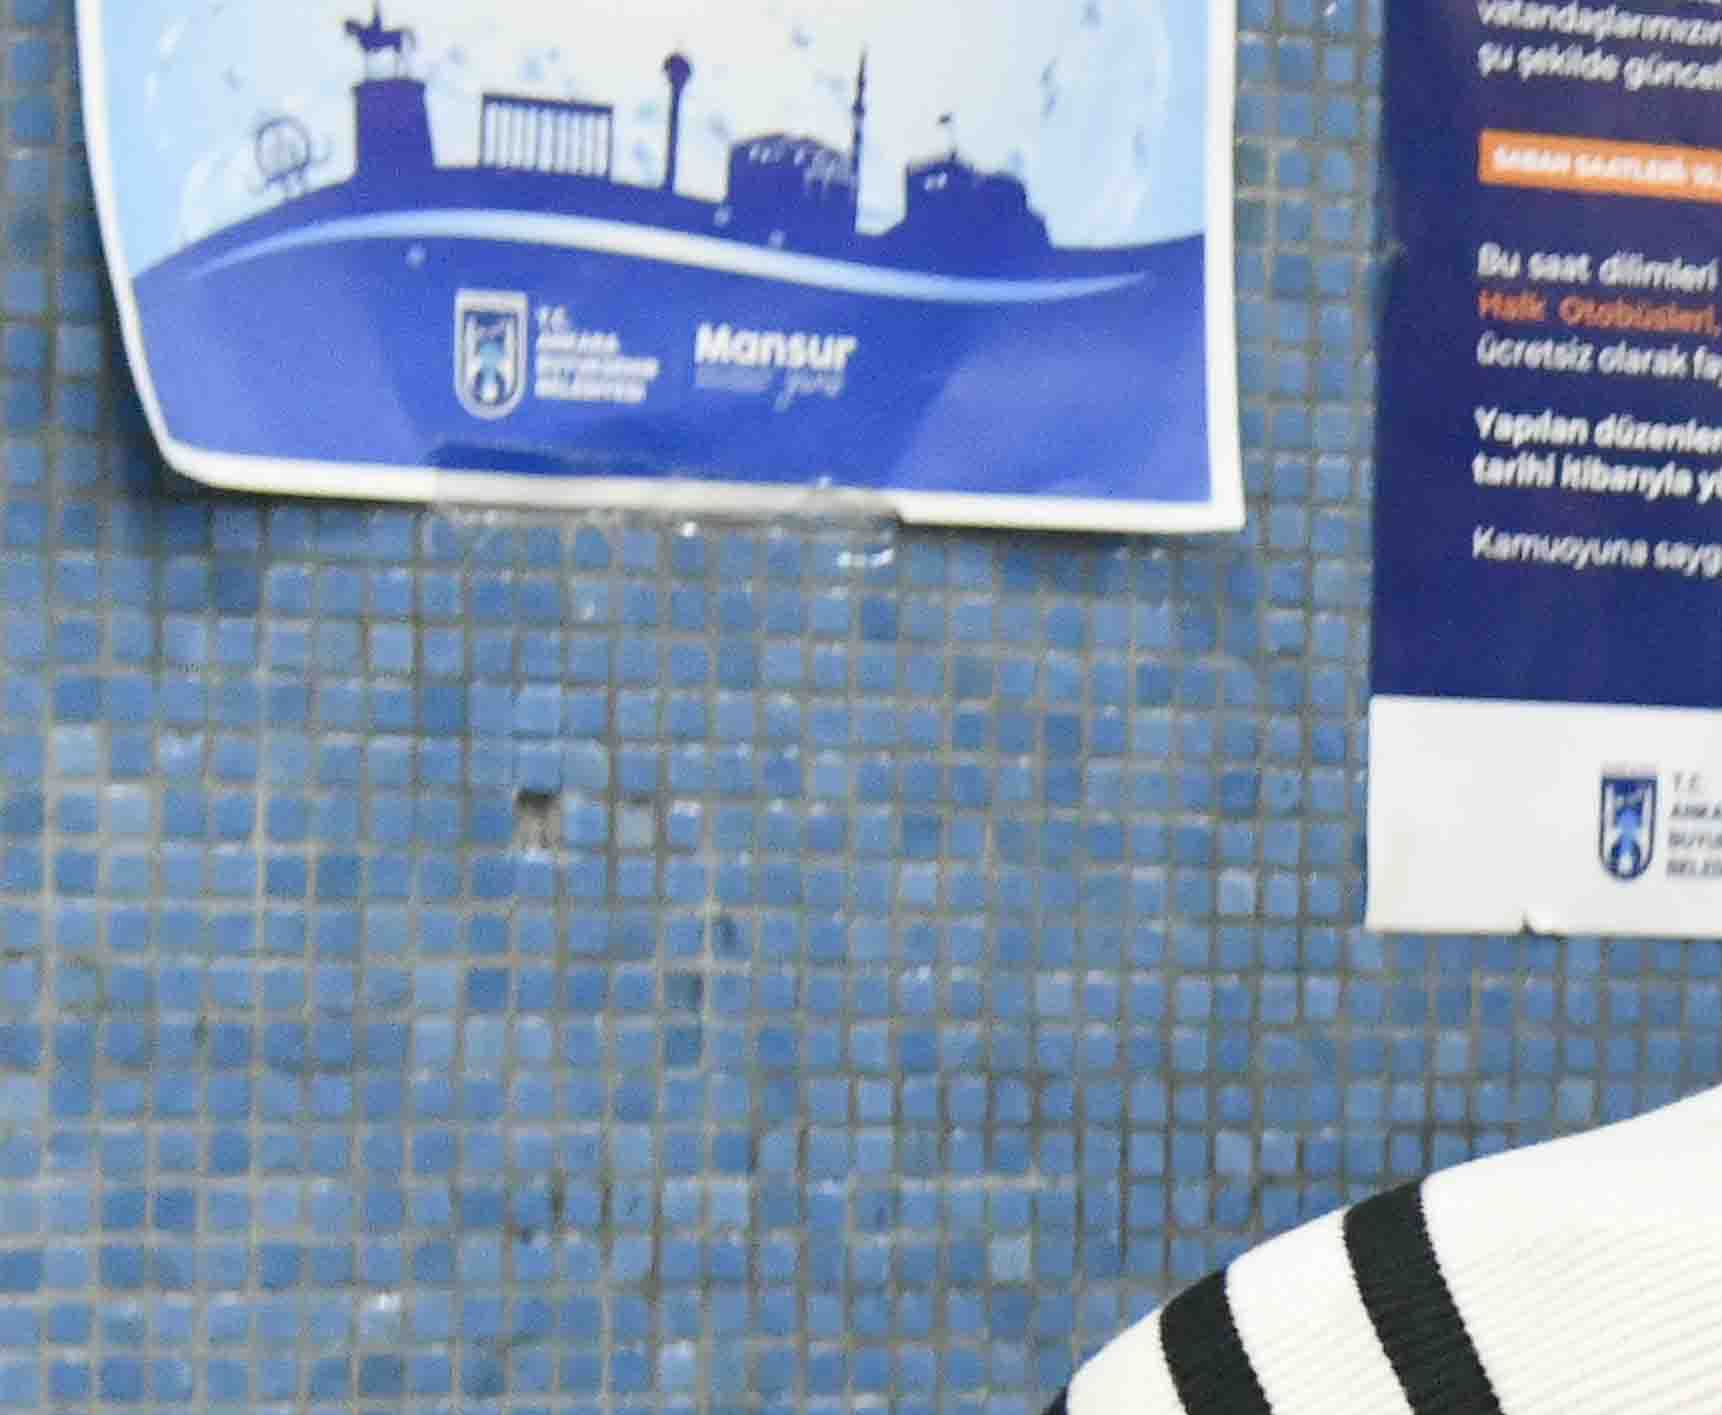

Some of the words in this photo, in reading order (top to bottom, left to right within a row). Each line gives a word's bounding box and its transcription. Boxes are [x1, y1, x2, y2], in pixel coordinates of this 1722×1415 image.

[1478, 41, 1514, 78] şu
[1518, 44, 1620, 81] şekilde
[1478, 242, 1521, 278] Bu
[1528, 252, 1592, 284] saat
[1599, 249, 1718, 293] dilimleri
[1479, 289, 1546, 324] Halk
[1558, 294, 1721, 337] Otobüsleri,
[694, 321, 858, 373] Mansur
[1598, 341, 1690, 379] olarak
[1475, 406, 1590, 448] Yapılan
[1472, 450, 1556, 488] tarihi
[1561, 452, 1694, 501] itibarıyla
[1472, 524, 1650, 570] Kamuoyuna
